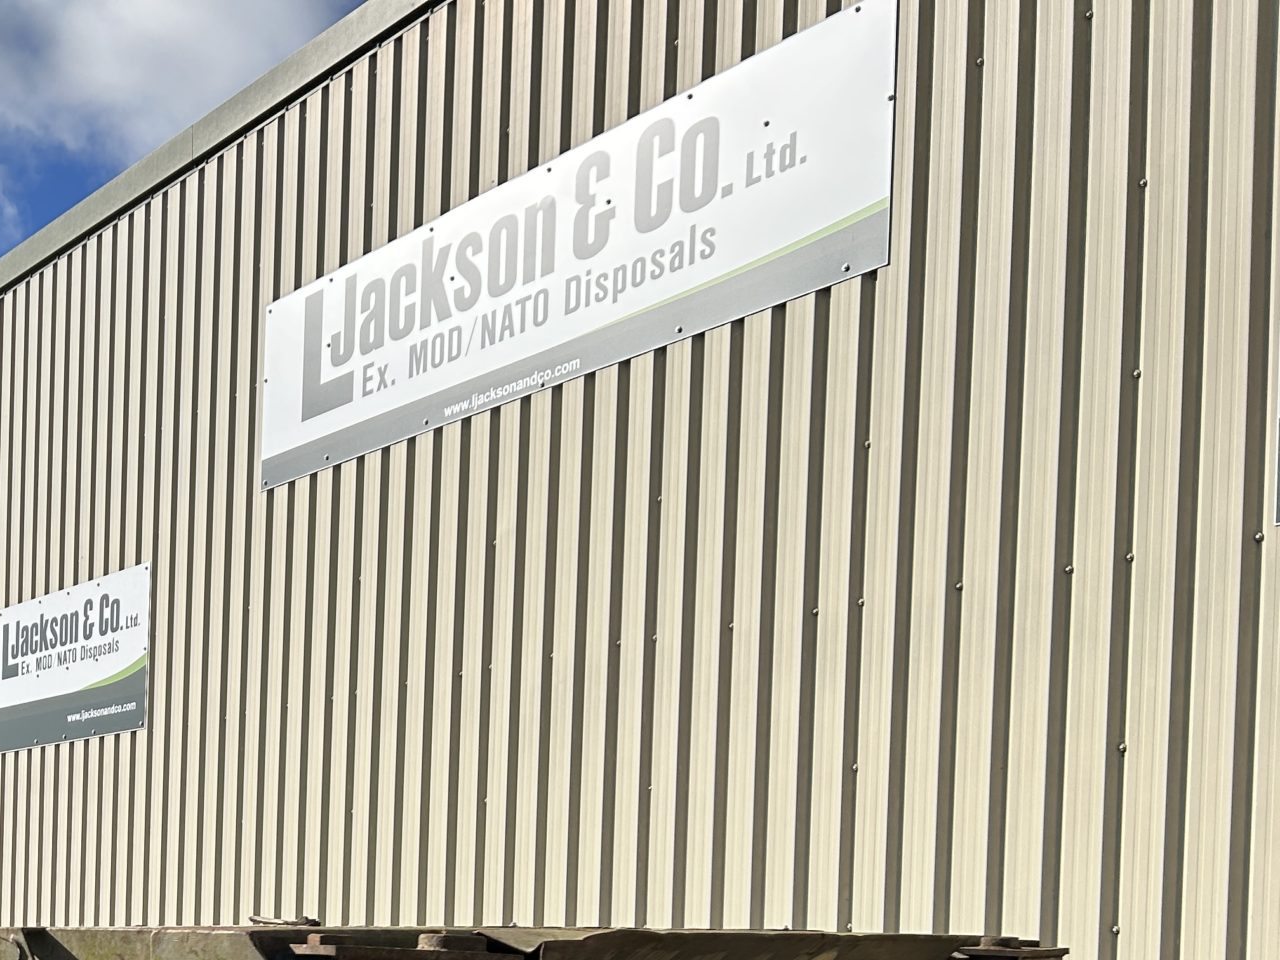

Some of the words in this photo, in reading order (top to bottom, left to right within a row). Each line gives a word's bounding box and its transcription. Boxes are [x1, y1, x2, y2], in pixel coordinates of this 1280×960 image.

[573, 151, 616, 260] &
[634, 116, 733, 233] Co.
[745, 131, 807, 188] Ltd.
[362, 361, 396, 398] Ex.
[408, 288, 549, 379] MOD/NATO
[565, 224, 716, 315] Disposals
[443, 358, 581, 417] www.ljacksonandco.com
[83, 598, 94, 640] &
[99, 593, 123, 636] Co.
[125, 613, 140, 629] Ltd.
[21, 660, 32, 675] Ex.
[36, 648, 76, 672] MOD/NATO
[80, 638, 119, 661] Disposals
